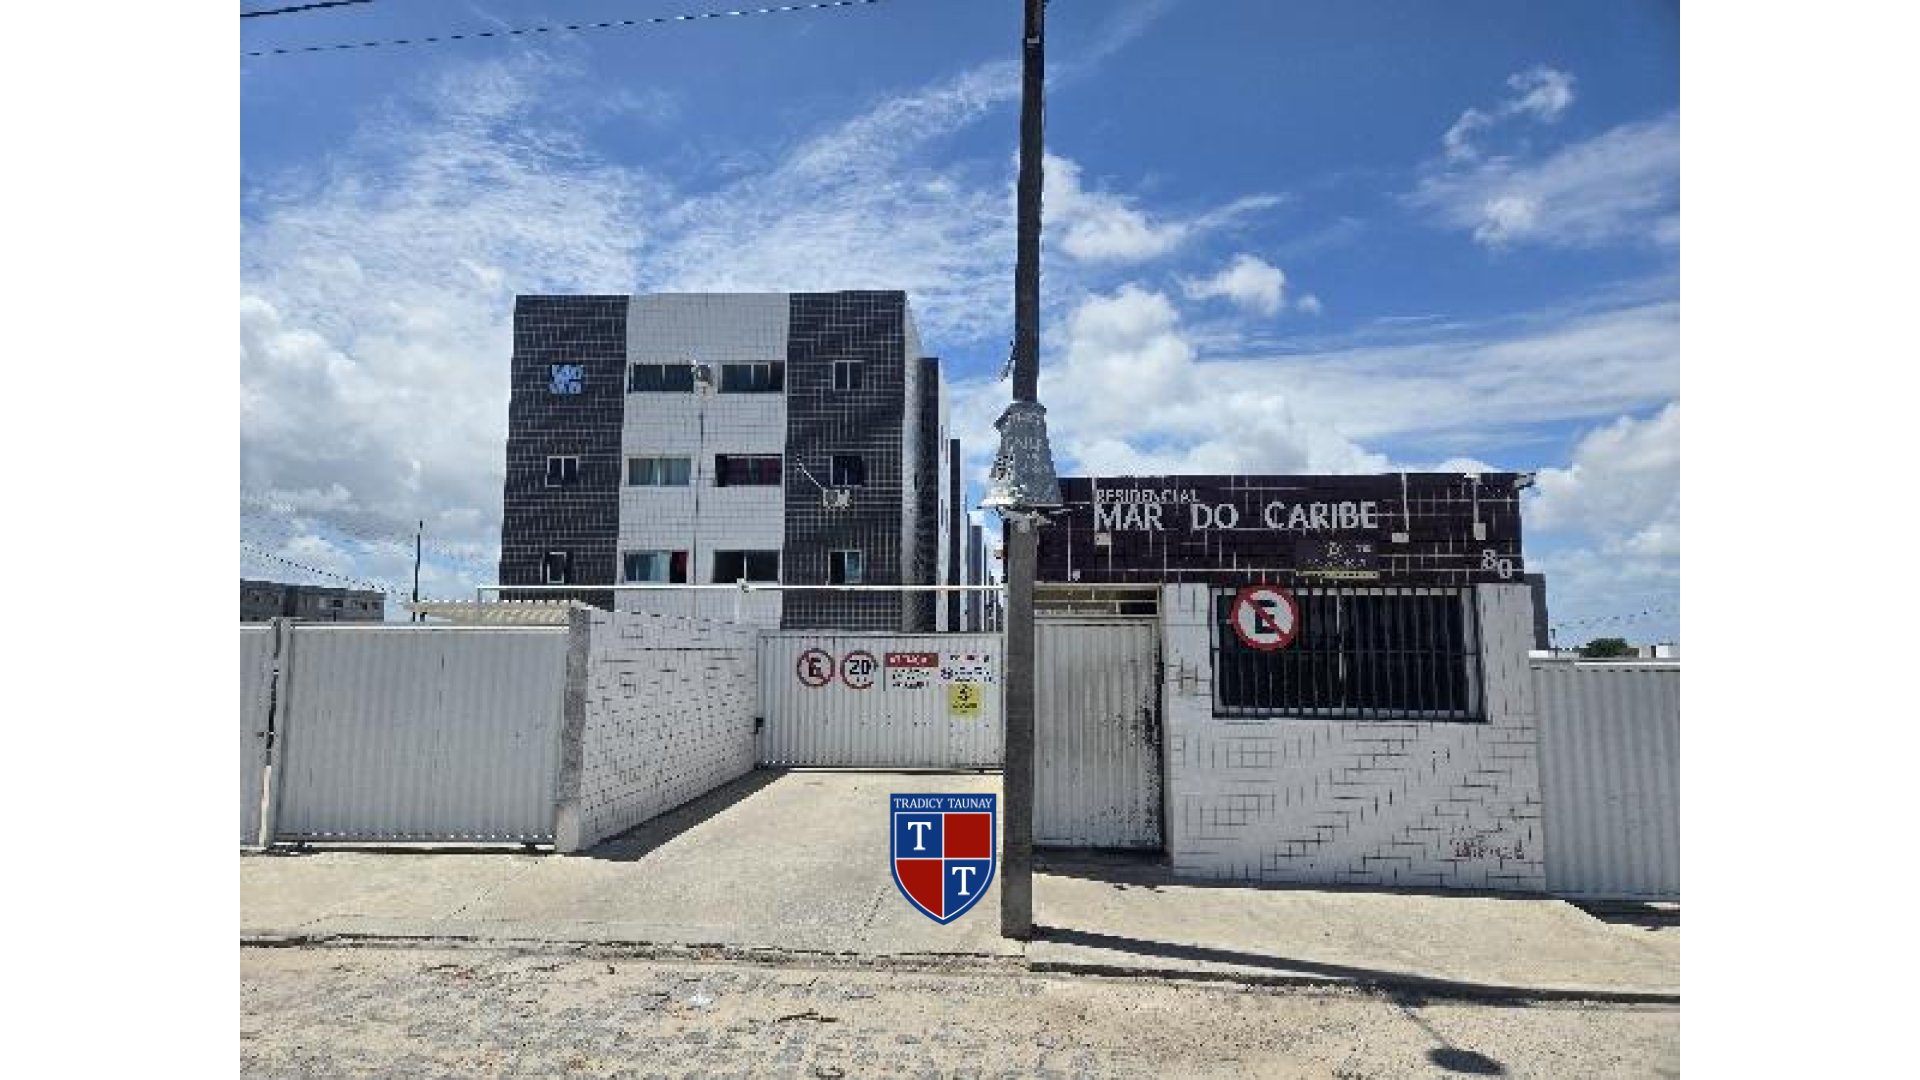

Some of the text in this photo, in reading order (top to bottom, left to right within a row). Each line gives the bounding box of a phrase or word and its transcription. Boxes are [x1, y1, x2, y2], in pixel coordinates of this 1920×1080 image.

[1096, 488, 1200, 504] RESIDENCIAL
[1095, 500, 1379, 531] MAR DO CARIBE
[1481, 548, 1514, 579] 80
[849, 659, 871, 676] 20
